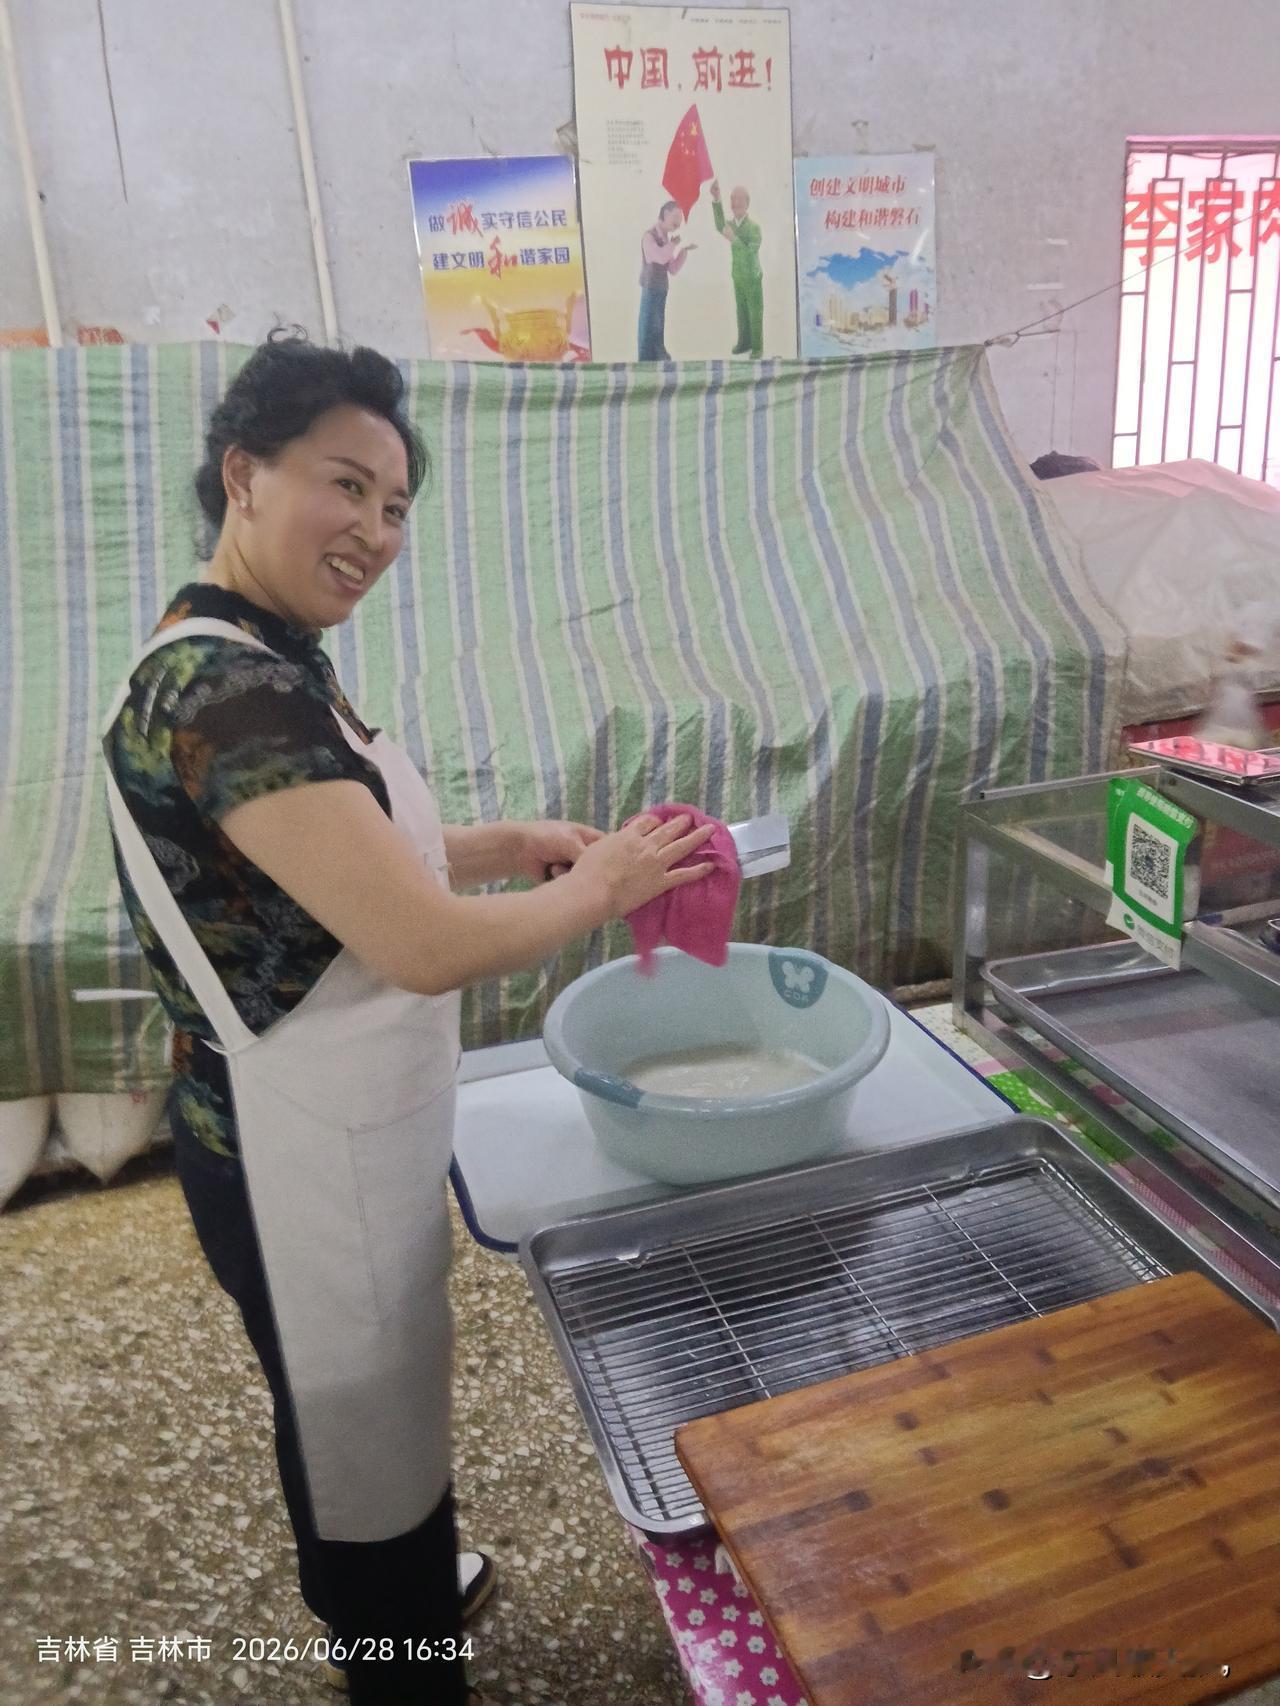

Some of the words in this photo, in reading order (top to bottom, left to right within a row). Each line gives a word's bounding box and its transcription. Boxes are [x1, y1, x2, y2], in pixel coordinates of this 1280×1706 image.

[810, 175, 906, 197] 创建文明城市
[428, 202, 567, 238] 做诚实守信公民
[824, 206, 921, 230] 构建和谐磐石
[432, 235, 570, 280] 建文明和谐家园
